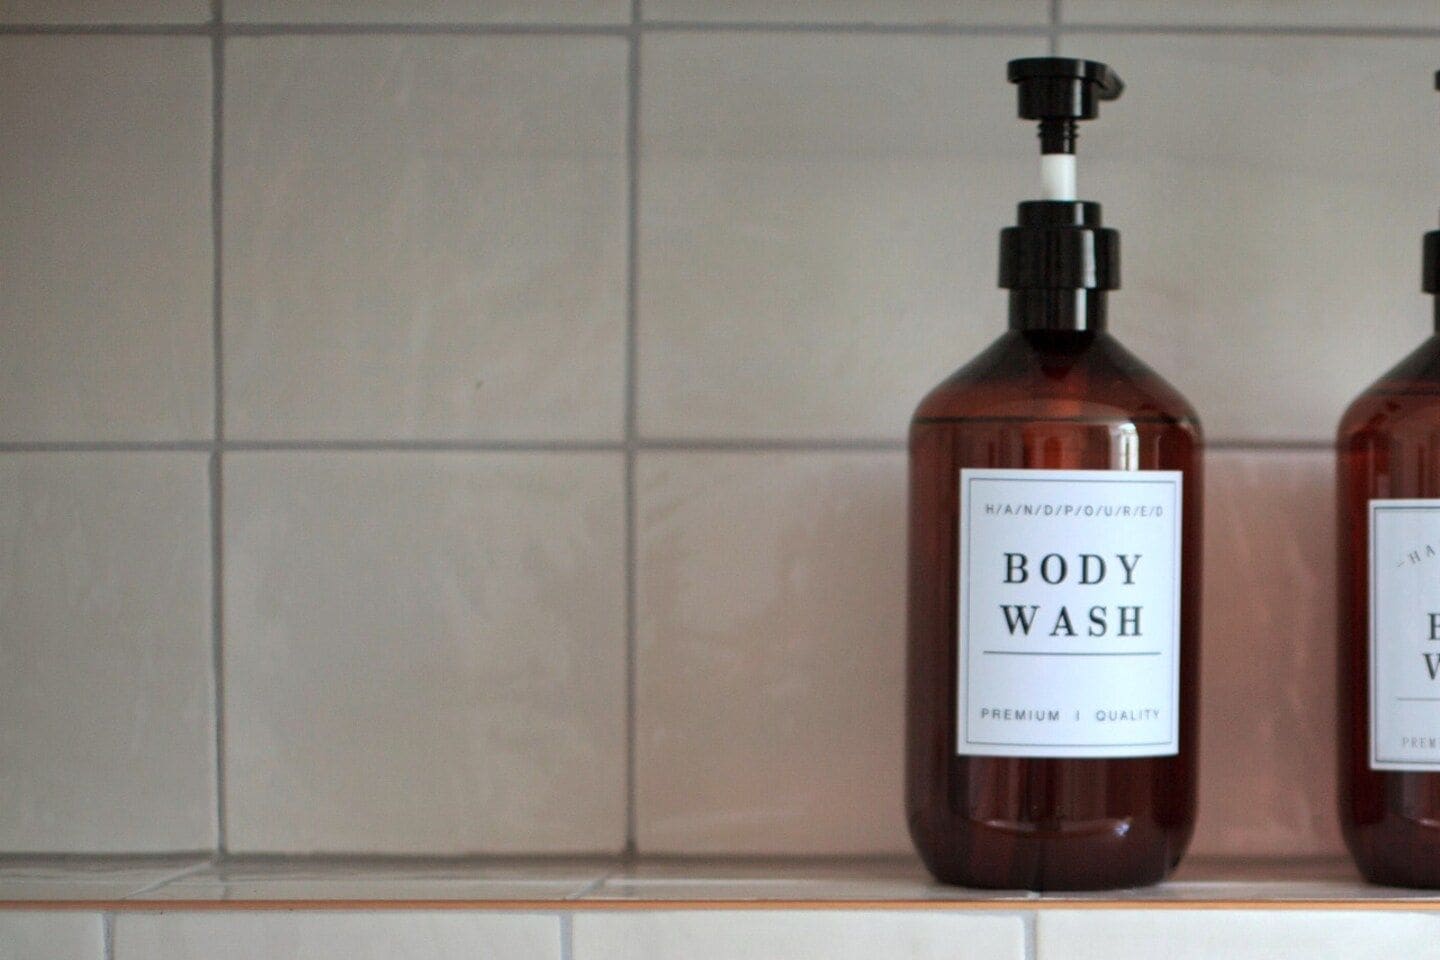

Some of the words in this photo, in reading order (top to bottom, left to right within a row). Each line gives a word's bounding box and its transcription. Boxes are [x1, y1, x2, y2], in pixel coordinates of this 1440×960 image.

[1003, 552, 1143, 585] BODY
[1000, 604, 1144, 637] WASH
[980, 707, 1060, 721] PREMIUM
[1096, 708, 1161, 722] QUALITY
